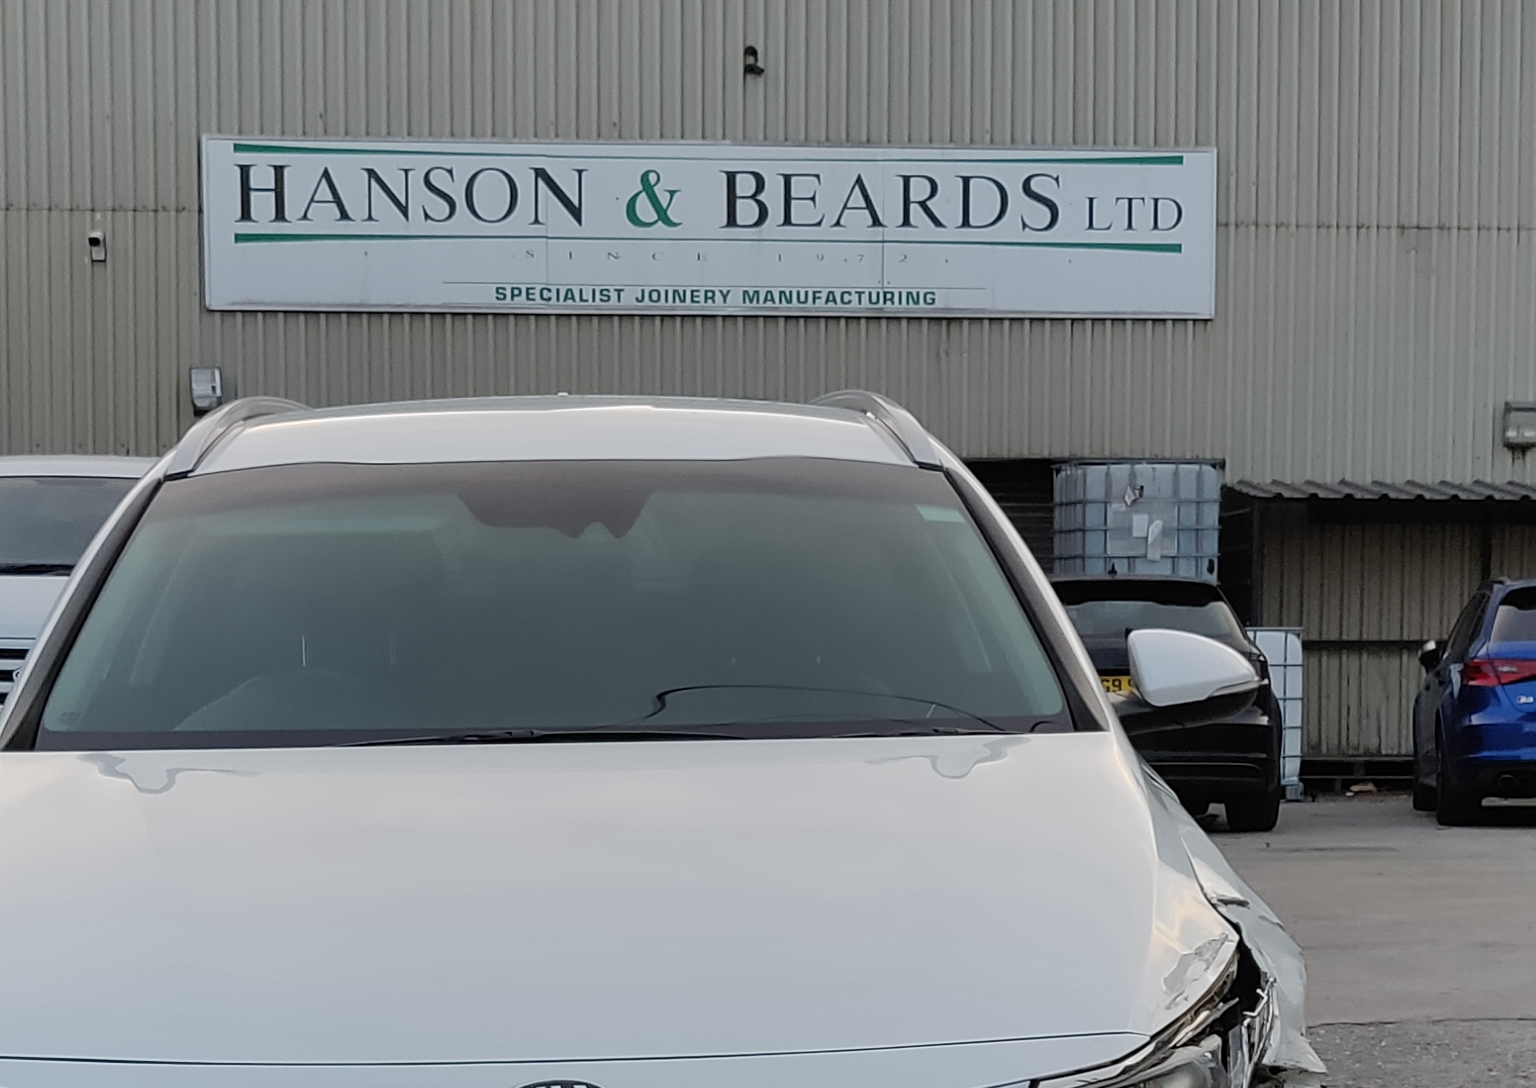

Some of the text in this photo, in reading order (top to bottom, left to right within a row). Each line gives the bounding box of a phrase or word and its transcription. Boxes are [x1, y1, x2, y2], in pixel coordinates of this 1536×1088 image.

[233, 163, 1183, 233] HANSON & BEARDS LTD
[494, 285, 938, 306] SPECIALIST JOINERY MANUFACTURING
